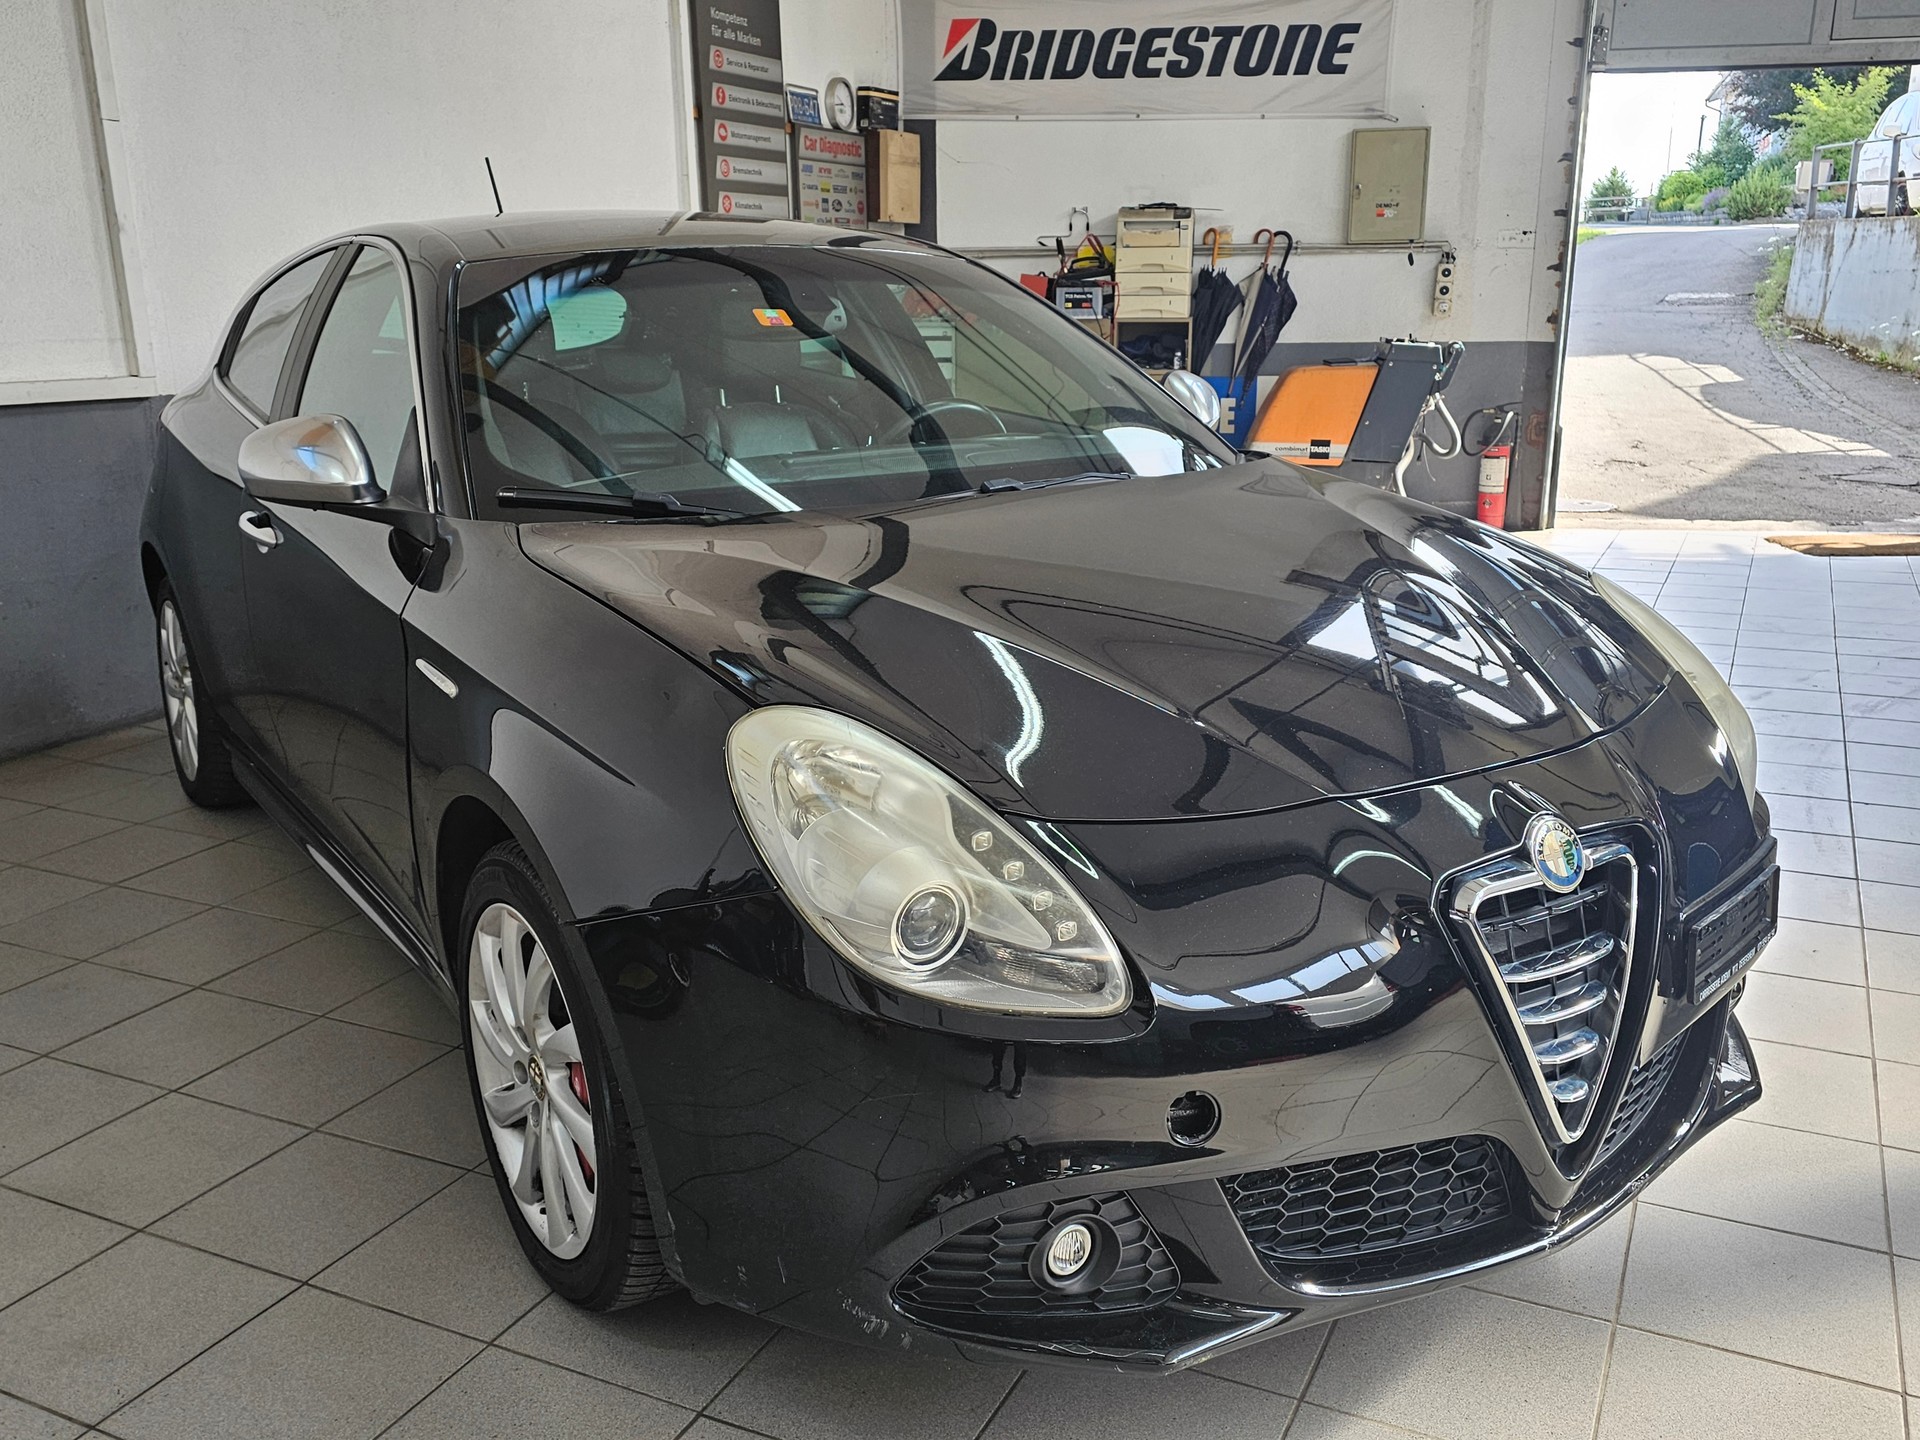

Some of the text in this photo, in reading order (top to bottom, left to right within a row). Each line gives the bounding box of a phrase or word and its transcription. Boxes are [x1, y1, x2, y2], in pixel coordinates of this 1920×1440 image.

[710, 6, 748, 27] Kompetenz
[723, 28, 736, 41] alle
[737, 30, 762, 47] Marken
[932, 18, 1363, 82] BRIDGESTONE
[726, 57, 743, 69] Service
[748, 62, 770, 73] Reparatur
[728, 94, 751, 106] Elektronik
[756, 99, 782, 112] Beleuchtung
[731, 130, 772, 143] Motormanagement
[804, 135, 863, 159] Car Diagnostic
[733, 165, 763, 177] Bremstechnik
[735, 201, 763, 211] Klimatechnik
[1275, 445, 1308, 453] combimat
[1310, 445, 1330, 454] TASKI
